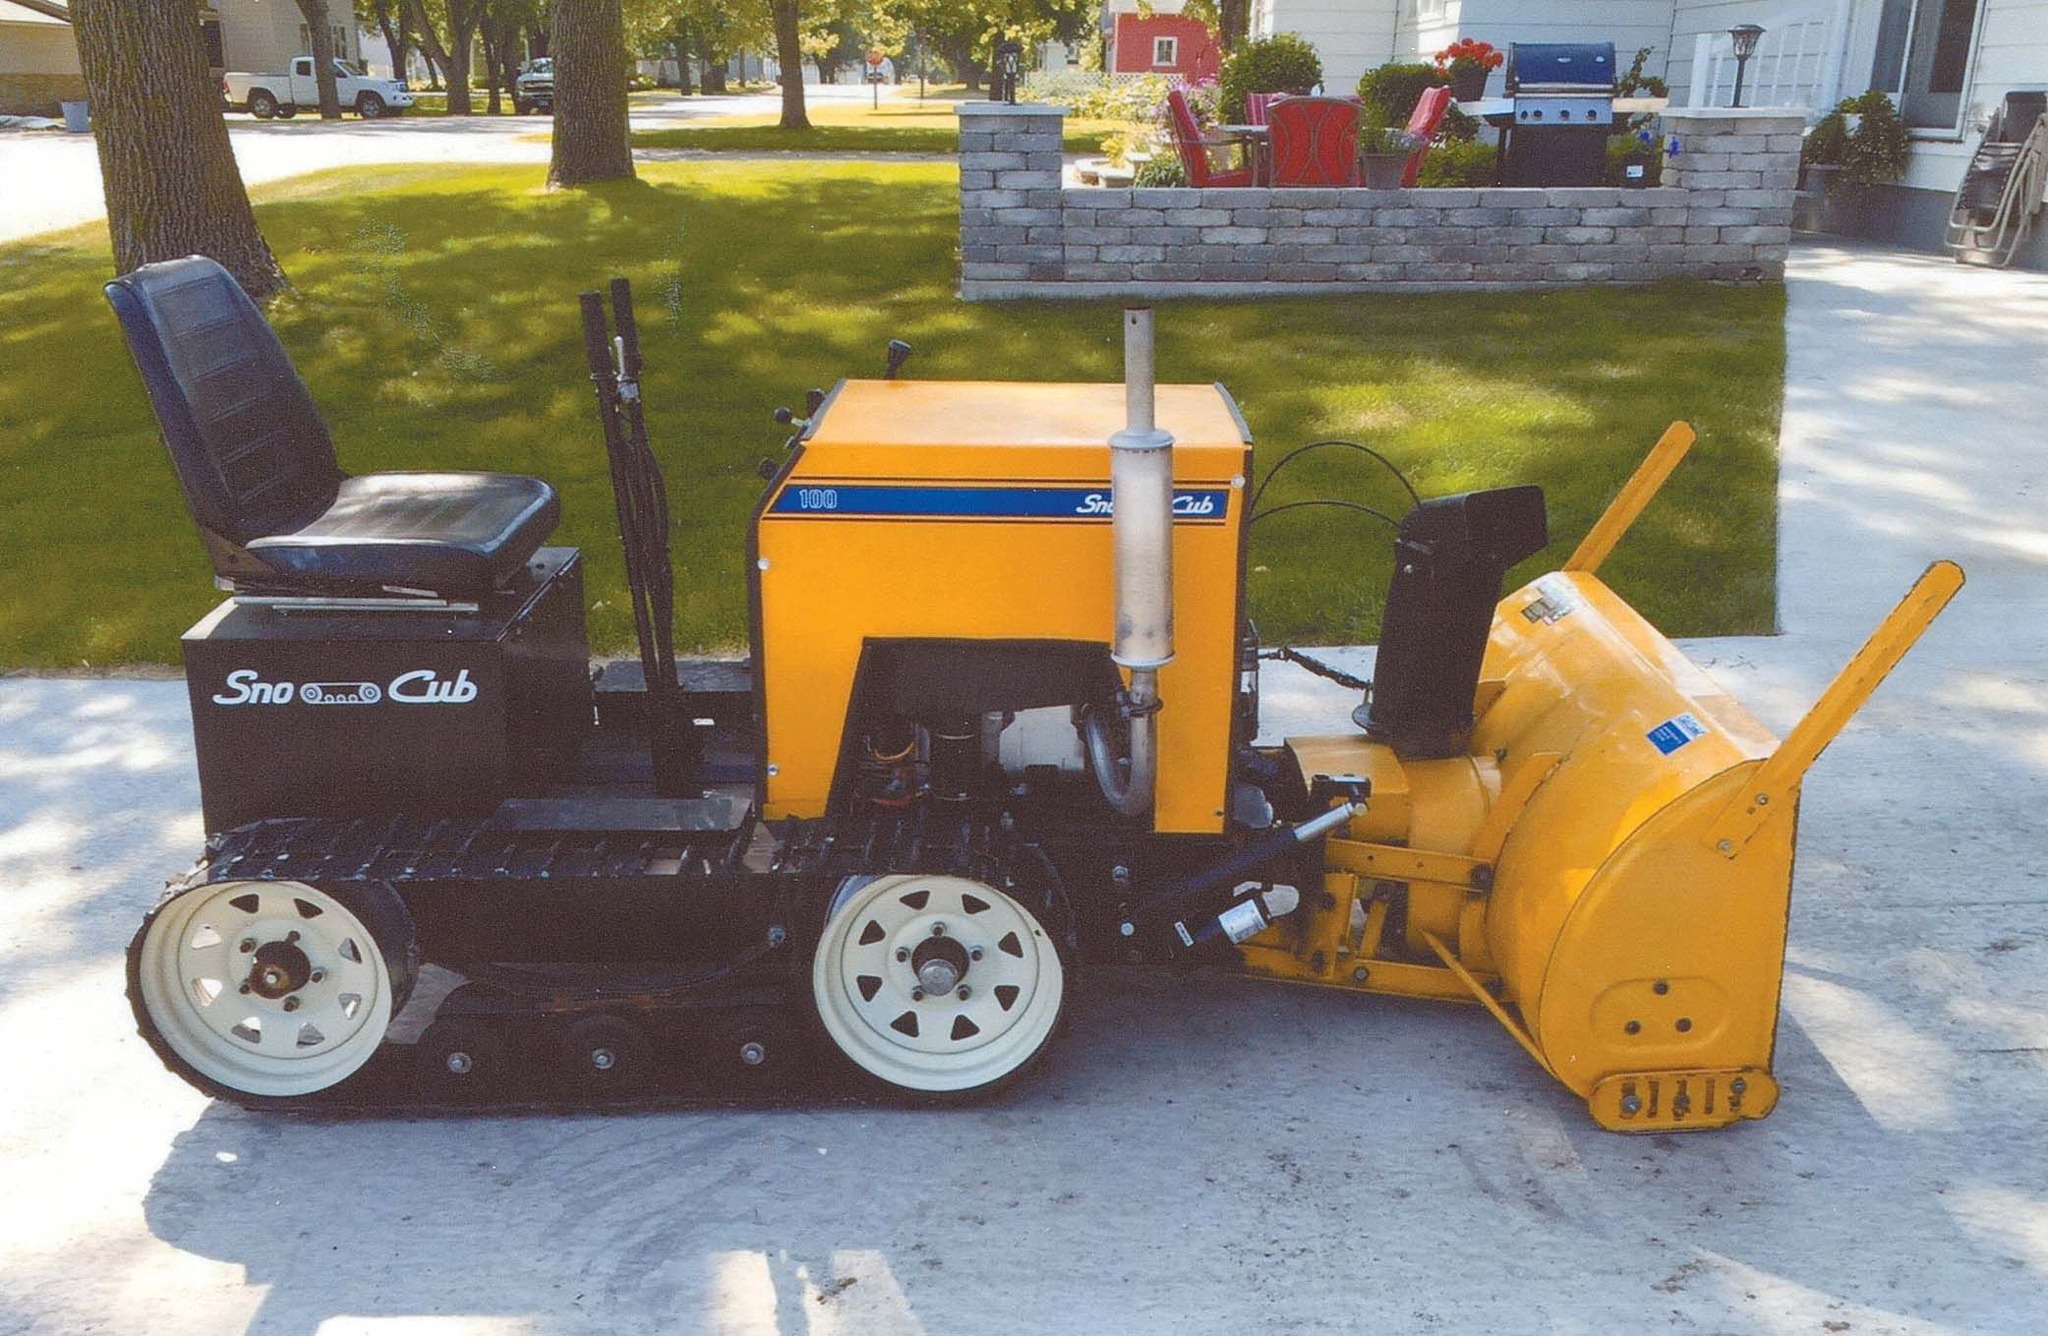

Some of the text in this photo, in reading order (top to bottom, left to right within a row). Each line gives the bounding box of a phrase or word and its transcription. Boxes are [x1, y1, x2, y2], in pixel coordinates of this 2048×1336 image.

[799, 489, 837, 508] 100
[1172, 496, 1213, 514] Cub
[212, 669, 478, 704] Sno Cub
